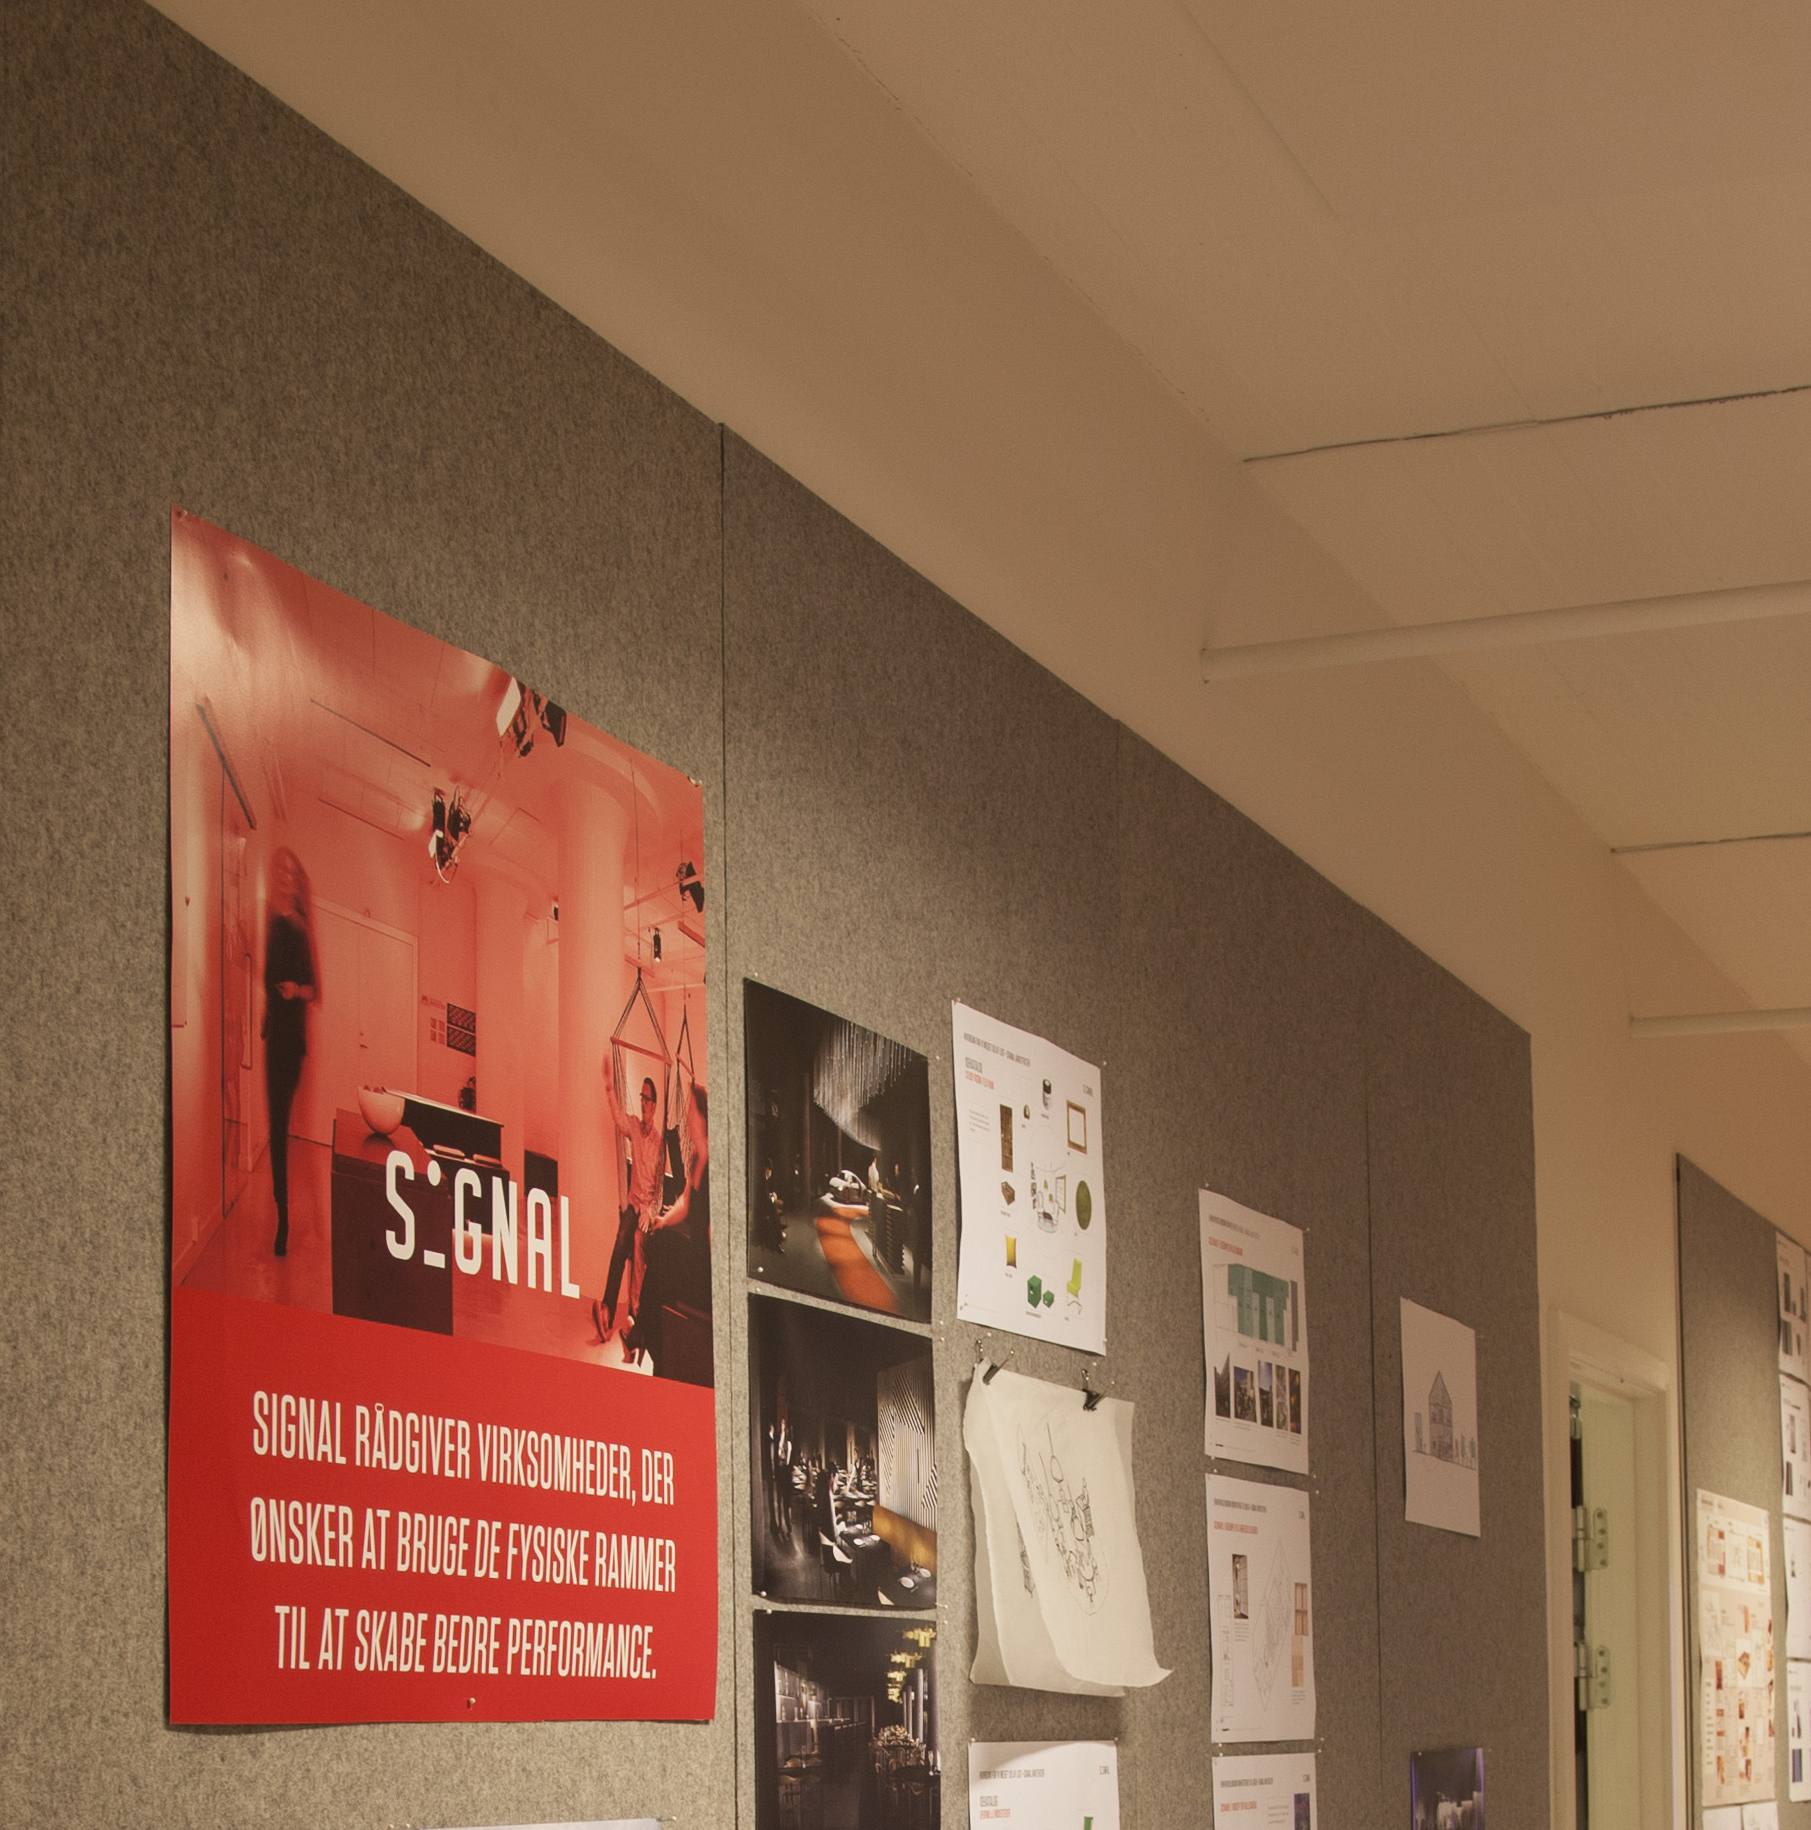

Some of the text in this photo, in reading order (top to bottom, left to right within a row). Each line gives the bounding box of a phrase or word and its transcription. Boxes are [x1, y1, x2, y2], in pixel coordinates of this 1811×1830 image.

[253, 1390, 675, 1507] SIGNAL RÅDGIVER VIRKSOMHEDER, DER
[250, 1497, 676, 1593] ØNSKER AT BRUGE DE FYSISKE RAMMER
[274, 1605, 658, 1680] TIL AT SKABE BEDRE PERFORMANCE.
